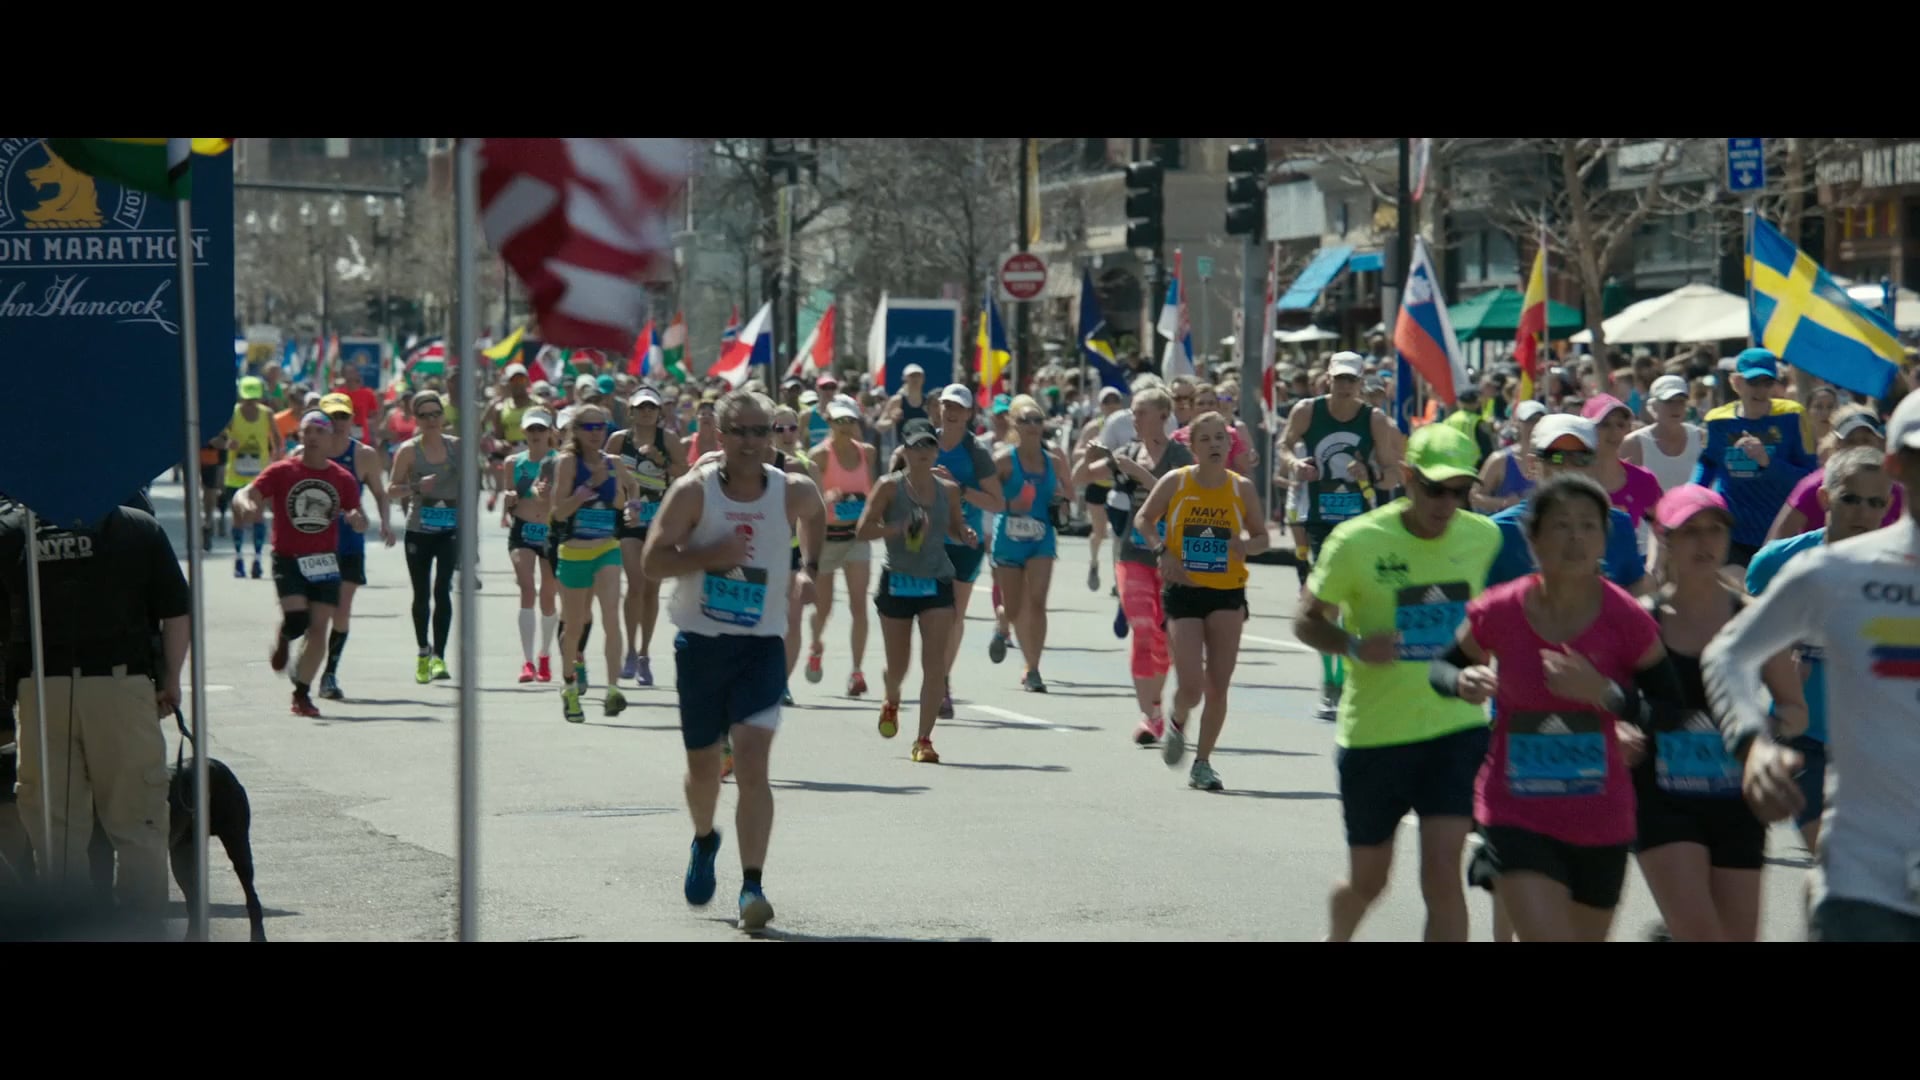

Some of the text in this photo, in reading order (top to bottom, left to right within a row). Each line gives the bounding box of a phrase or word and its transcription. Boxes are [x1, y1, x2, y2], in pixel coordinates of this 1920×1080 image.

[35, 273, 180, 335] Hancock
[1190, 506, 1228, 518] NAVY
[36, 535, 93, 557] NYPD
[1183, 539, 1228, 554] 16856
[704, 580, 765, 604] 19416
[1861, 581, 1920, 606] COL
